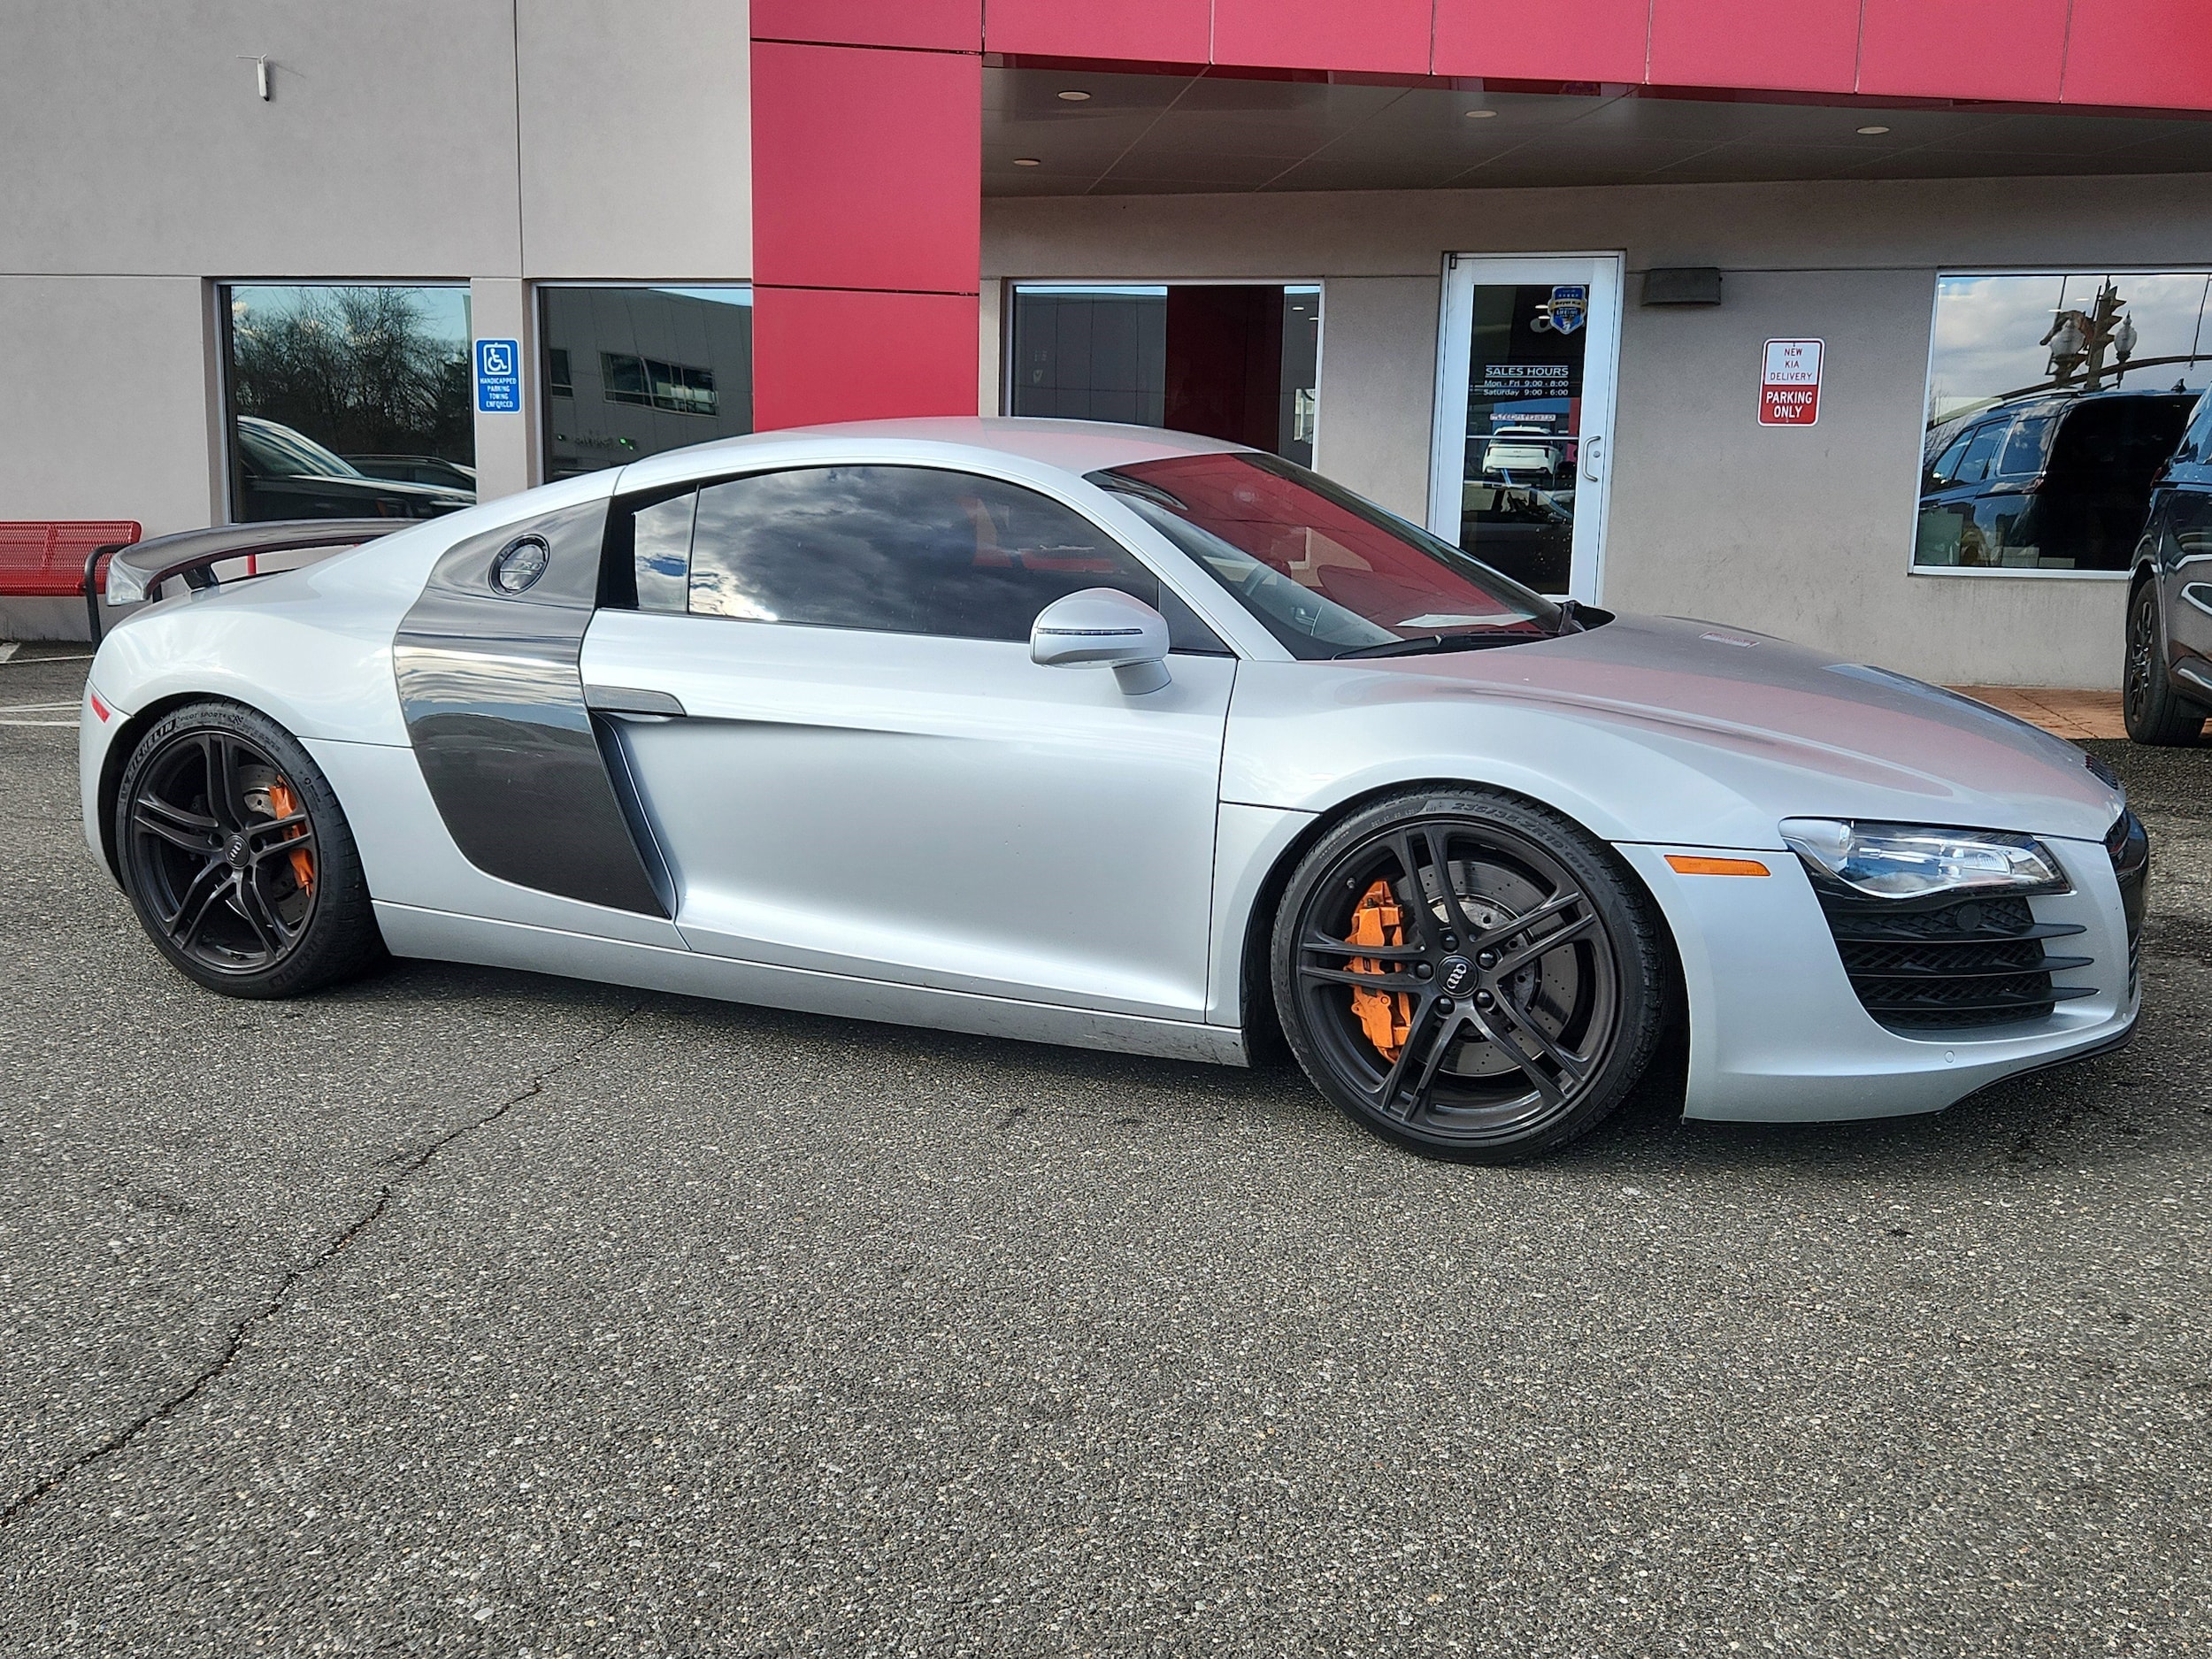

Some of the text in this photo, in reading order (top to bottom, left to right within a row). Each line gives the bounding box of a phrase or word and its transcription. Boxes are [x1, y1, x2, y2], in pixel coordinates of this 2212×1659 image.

[1784, 348, 1802, 357] NEW
[1485, 367, 1569, 376] SALES HOURS
[1770, 372, 1813, 380] DELIVERY
[1765, 391, 1813, 404] PARKING
[1773, 405, 1803, 419] ONLY
[127, 720, 173, 780] MICHELIN
